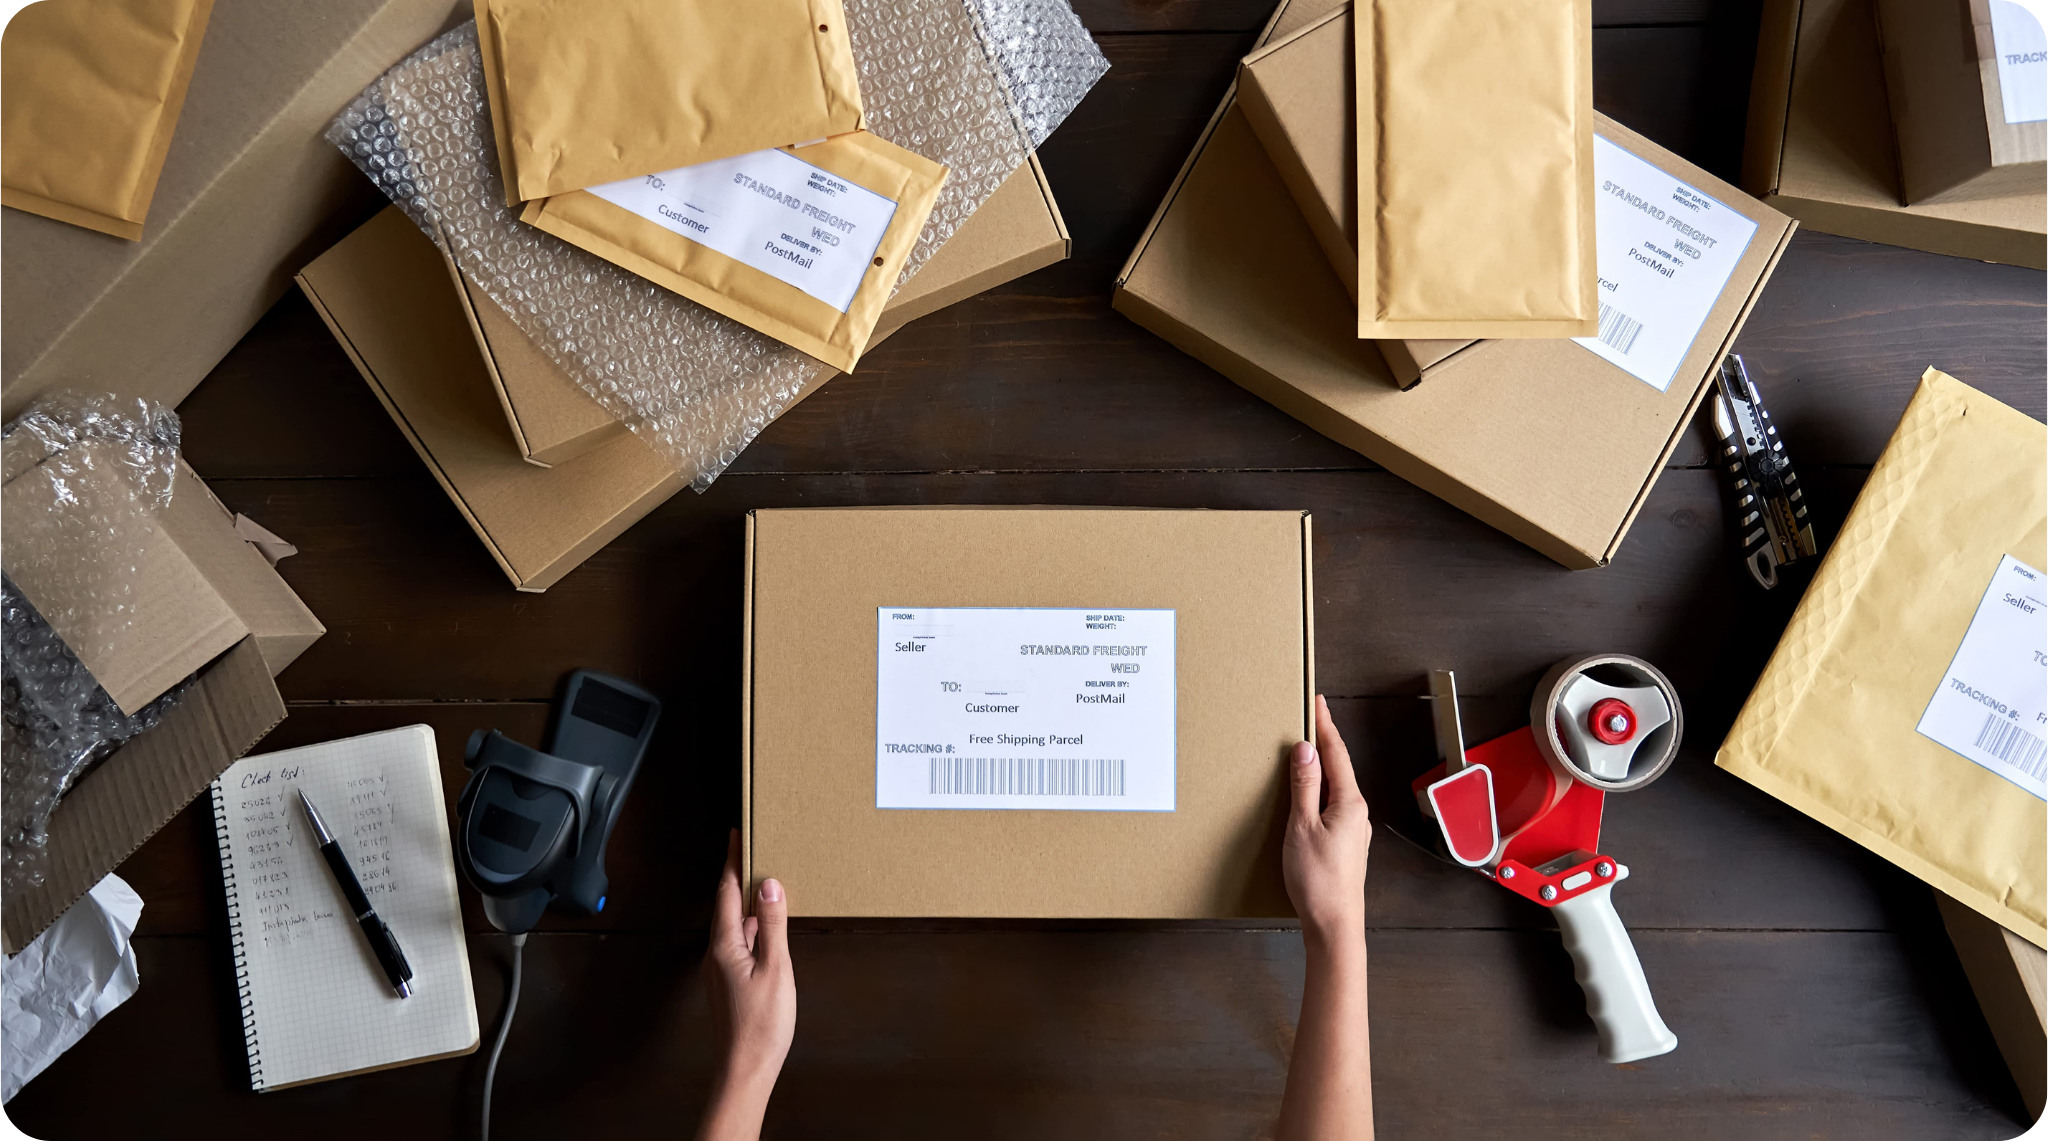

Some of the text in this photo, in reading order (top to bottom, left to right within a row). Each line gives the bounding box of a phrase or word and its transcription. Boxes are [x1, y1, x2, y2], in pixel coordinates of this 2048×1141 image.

[2004, 51, 2048, 65] TRACK
[646, 174, 666, 191] TO:
[807, 180, 836, 197] WEIGHT:
[810, 172, 848, 194] SHIP DATE:
[733, 172, 856, 234] STANDARD FREIGHT
[1672, 193, 1700, 213] WEIGHT:
[1676, 186, 1711, 210] SHIP DATE:
[658, 204, 710, 233] Customer
[1602, 180, 1718, 249] STANDARD FREIGHT
[780, 233, 823, 256] DELIVER BY:
[811, 226, 841, 247] WED
[764, 241, 814, 269] PostMail
[1644, 241, 1684, 268] DELIVER BY:
[1673, 238, 1702, 261] WED
[1628, 247, 1675, 279] PostMail
[1597, 276, 1619, 292] rcel
[2013, 565, 2037, 582] FROM:
[2003, 592, 2037, 614] Seller
[1085, 614, 1102, 622] SHIP
[895, 641, 927, 653] Seller
[1020, 644, 1148, 657] STANDARD FREIGHT
[1111, 663, 1140, 674] WED
[941, 681, 962, 693] TO:
[1076, 693, 1126, 704] PostMail
[1950, 677, 2008, 715] TRACKING
[965, 703, 1020, 713] Customer
[2036, 711, 2048, 726] Fr
[884, 743, 943, 754] TRACKING
[969, 734, 1084, 747] Free Shipping Parcel
